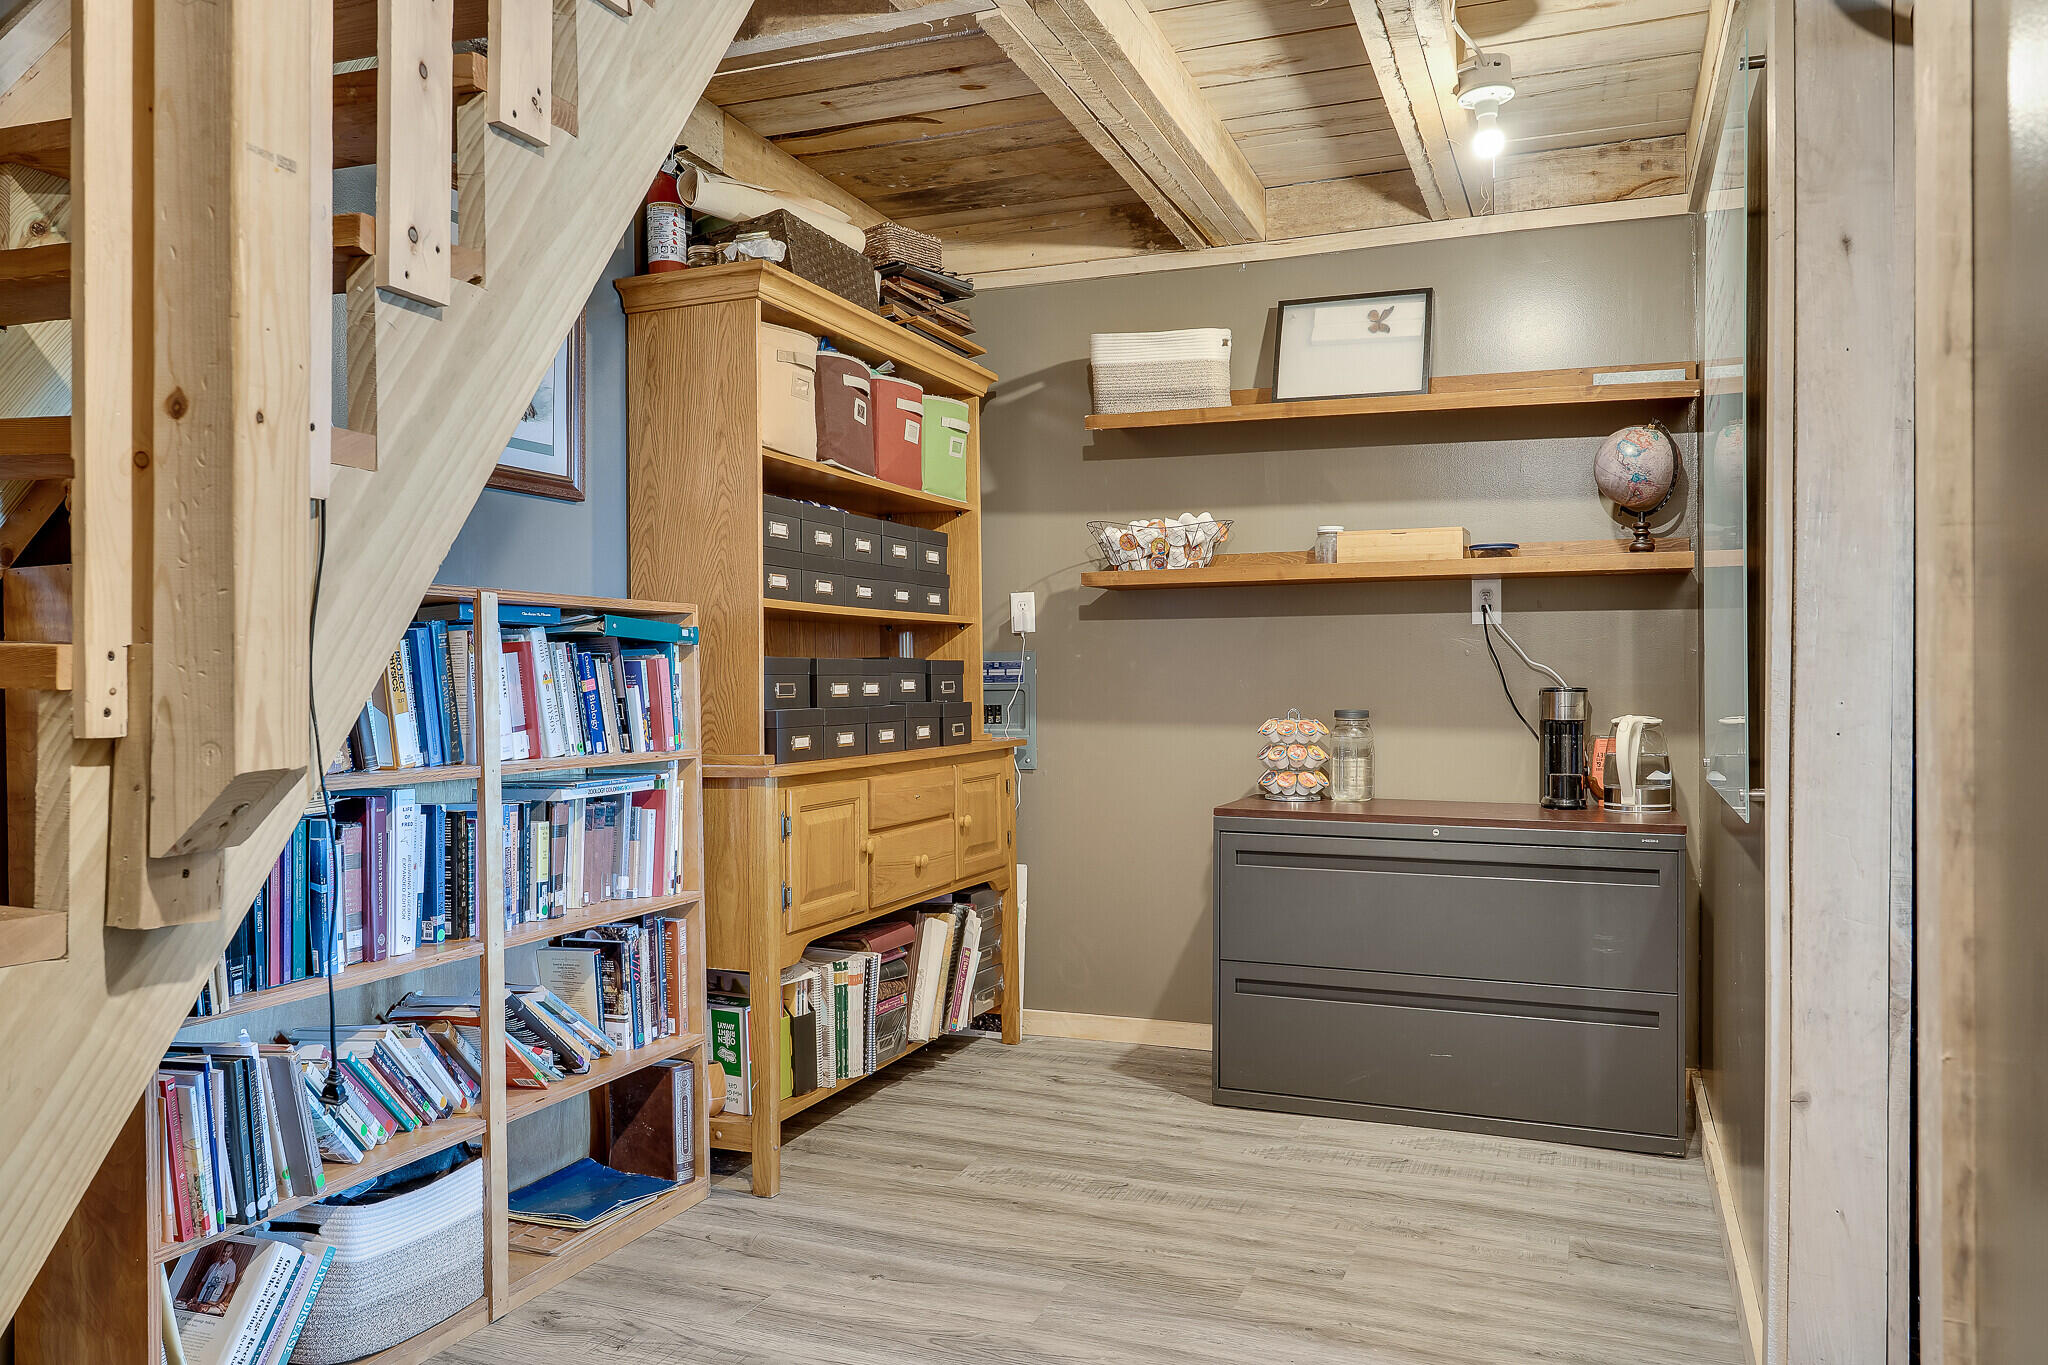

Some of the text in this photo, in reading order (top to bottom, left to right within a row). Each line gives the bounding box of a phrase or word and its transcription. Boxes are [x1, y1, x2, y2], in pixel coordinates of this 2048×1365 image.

[394, 650, 406, 694] PROJECT
[441, 675, 450, 714] SLAVERY
[444, 654, 460, 732] ARGUING ABOUT
[584, 656, 599, 731] Oxford Biology
[546, 697, 555, 733] BRYSON
[378, 872, 382, 880] TO
[631, 953, 640, 980] 1776
[716, 1022, 735, 1030] AWAY!
[718, 1029, 736, 1038] RIGHT
[718, 1036, 736, 1046] OPEN
[249, 1069, 260, 1124] REFORMATION
[354, 1088, 369, 1106] Nature
[168, 1095, 178, 1127] MADELEINE
[174, 1140, 184, 1170] COMMAND
[254, 1126, 262, 1156] HEROES
[274, 1256, 284, 1273] and
[262, 1275, 275, 1296] Meat
[273, 1264, 300, 1318] SAUSAGE
[308, 1266, 327, 1299] LYME
[237, 1260, 291, 1365] Great Sausage Recip
[246, 1299, 264, 1330] Curing
[273, 1284, 301, 1338] SAUSAGE-MAKING
[283, 1302, 311, 1356] DISEASE
